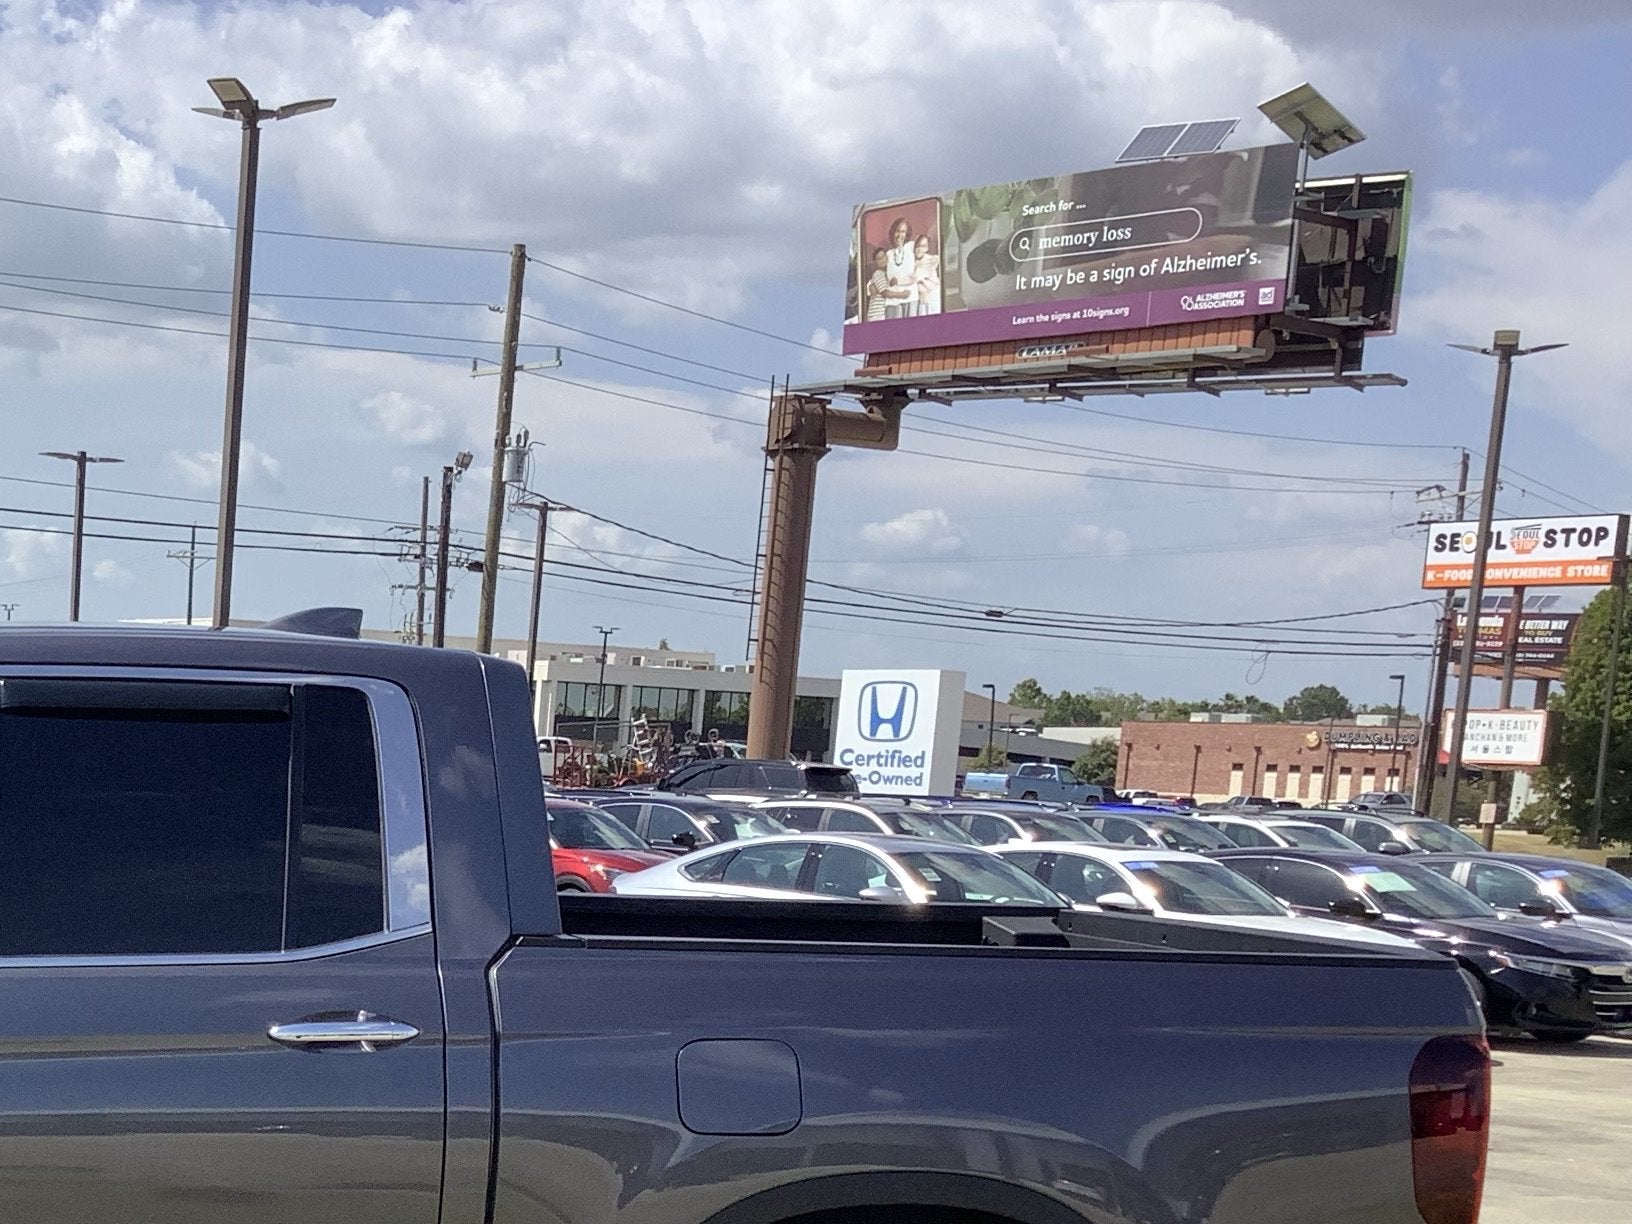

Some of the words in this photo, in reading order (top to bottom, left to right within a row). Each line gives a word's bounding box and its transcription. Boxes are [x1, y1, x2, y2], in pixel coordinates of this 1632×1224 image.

[1022, 201, 1056, 216] Search
[1058, 200, 1074, 212] for
[1039, 230, 1098, 250] memory
[1103, 226, 1132, 243] loss
[1016, 274, 1027, 290] It
[1031, 273, 1062, 291] may
[1067, 268, 1085, 284] be
[1089, 269, 1098, 282] a
[1103, 262, 1135, 285] sign
[1139, 258, 1158, 276] of
[1161, 248, 1262, 274] Alzheimer's.
[1194, 298, 1245, 310] ASSOCIATION
[1012, 314, 1035, 325] Learn
[1036, 312, 1050, 323] the
[1050, 311, 1071, 323] signs
[1072, 311, 1081, 320] at
[1082, 306, 1130, 320] 10signs.org
[1543, 526, 1609, 549] STOP
[1485, 565, 1562, 580] ONVENIENCE
[1566, 564, 1609, 578] STORE
[839, 747, 926, 769] Certified
[854, 770, 923, 787] e-Owned
